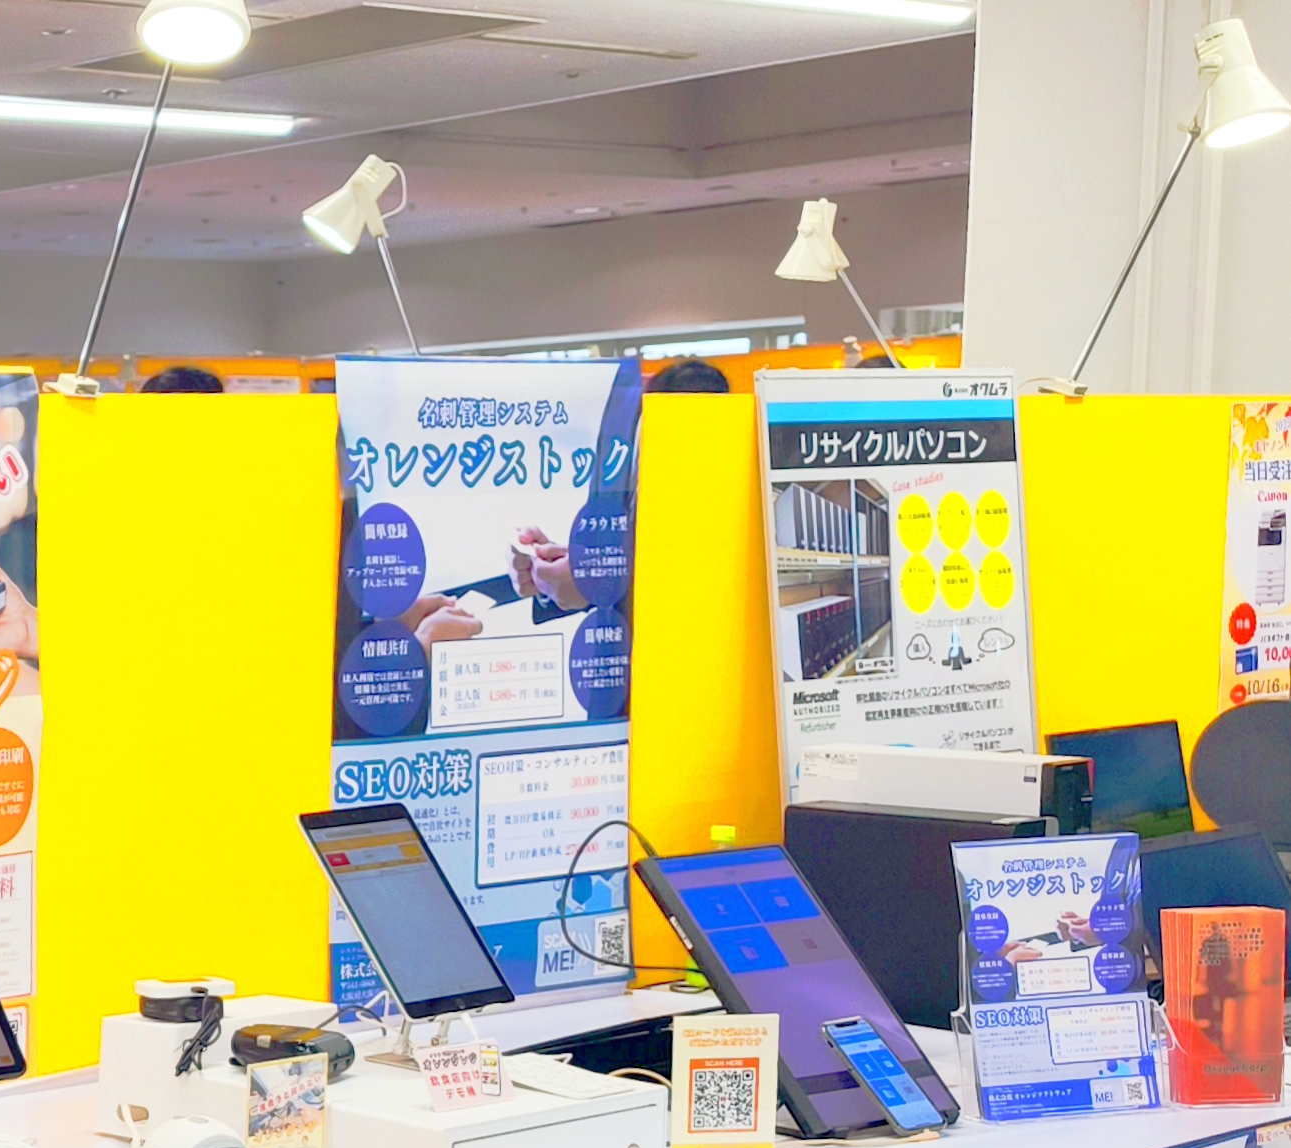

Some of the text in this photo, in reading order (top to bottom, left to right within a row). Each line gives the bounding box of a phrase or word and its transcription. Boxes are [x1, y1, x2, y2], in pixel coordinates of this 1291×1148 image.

[418, 396, 567, 428] 名刺管理システム
[349, 434, 629, 492] オレンジストック
[799, 428, 988, 465] リサイクルパソコン
[335, 750, 472, 803] SEO対策
[543, 948, 575, 975] ME!
